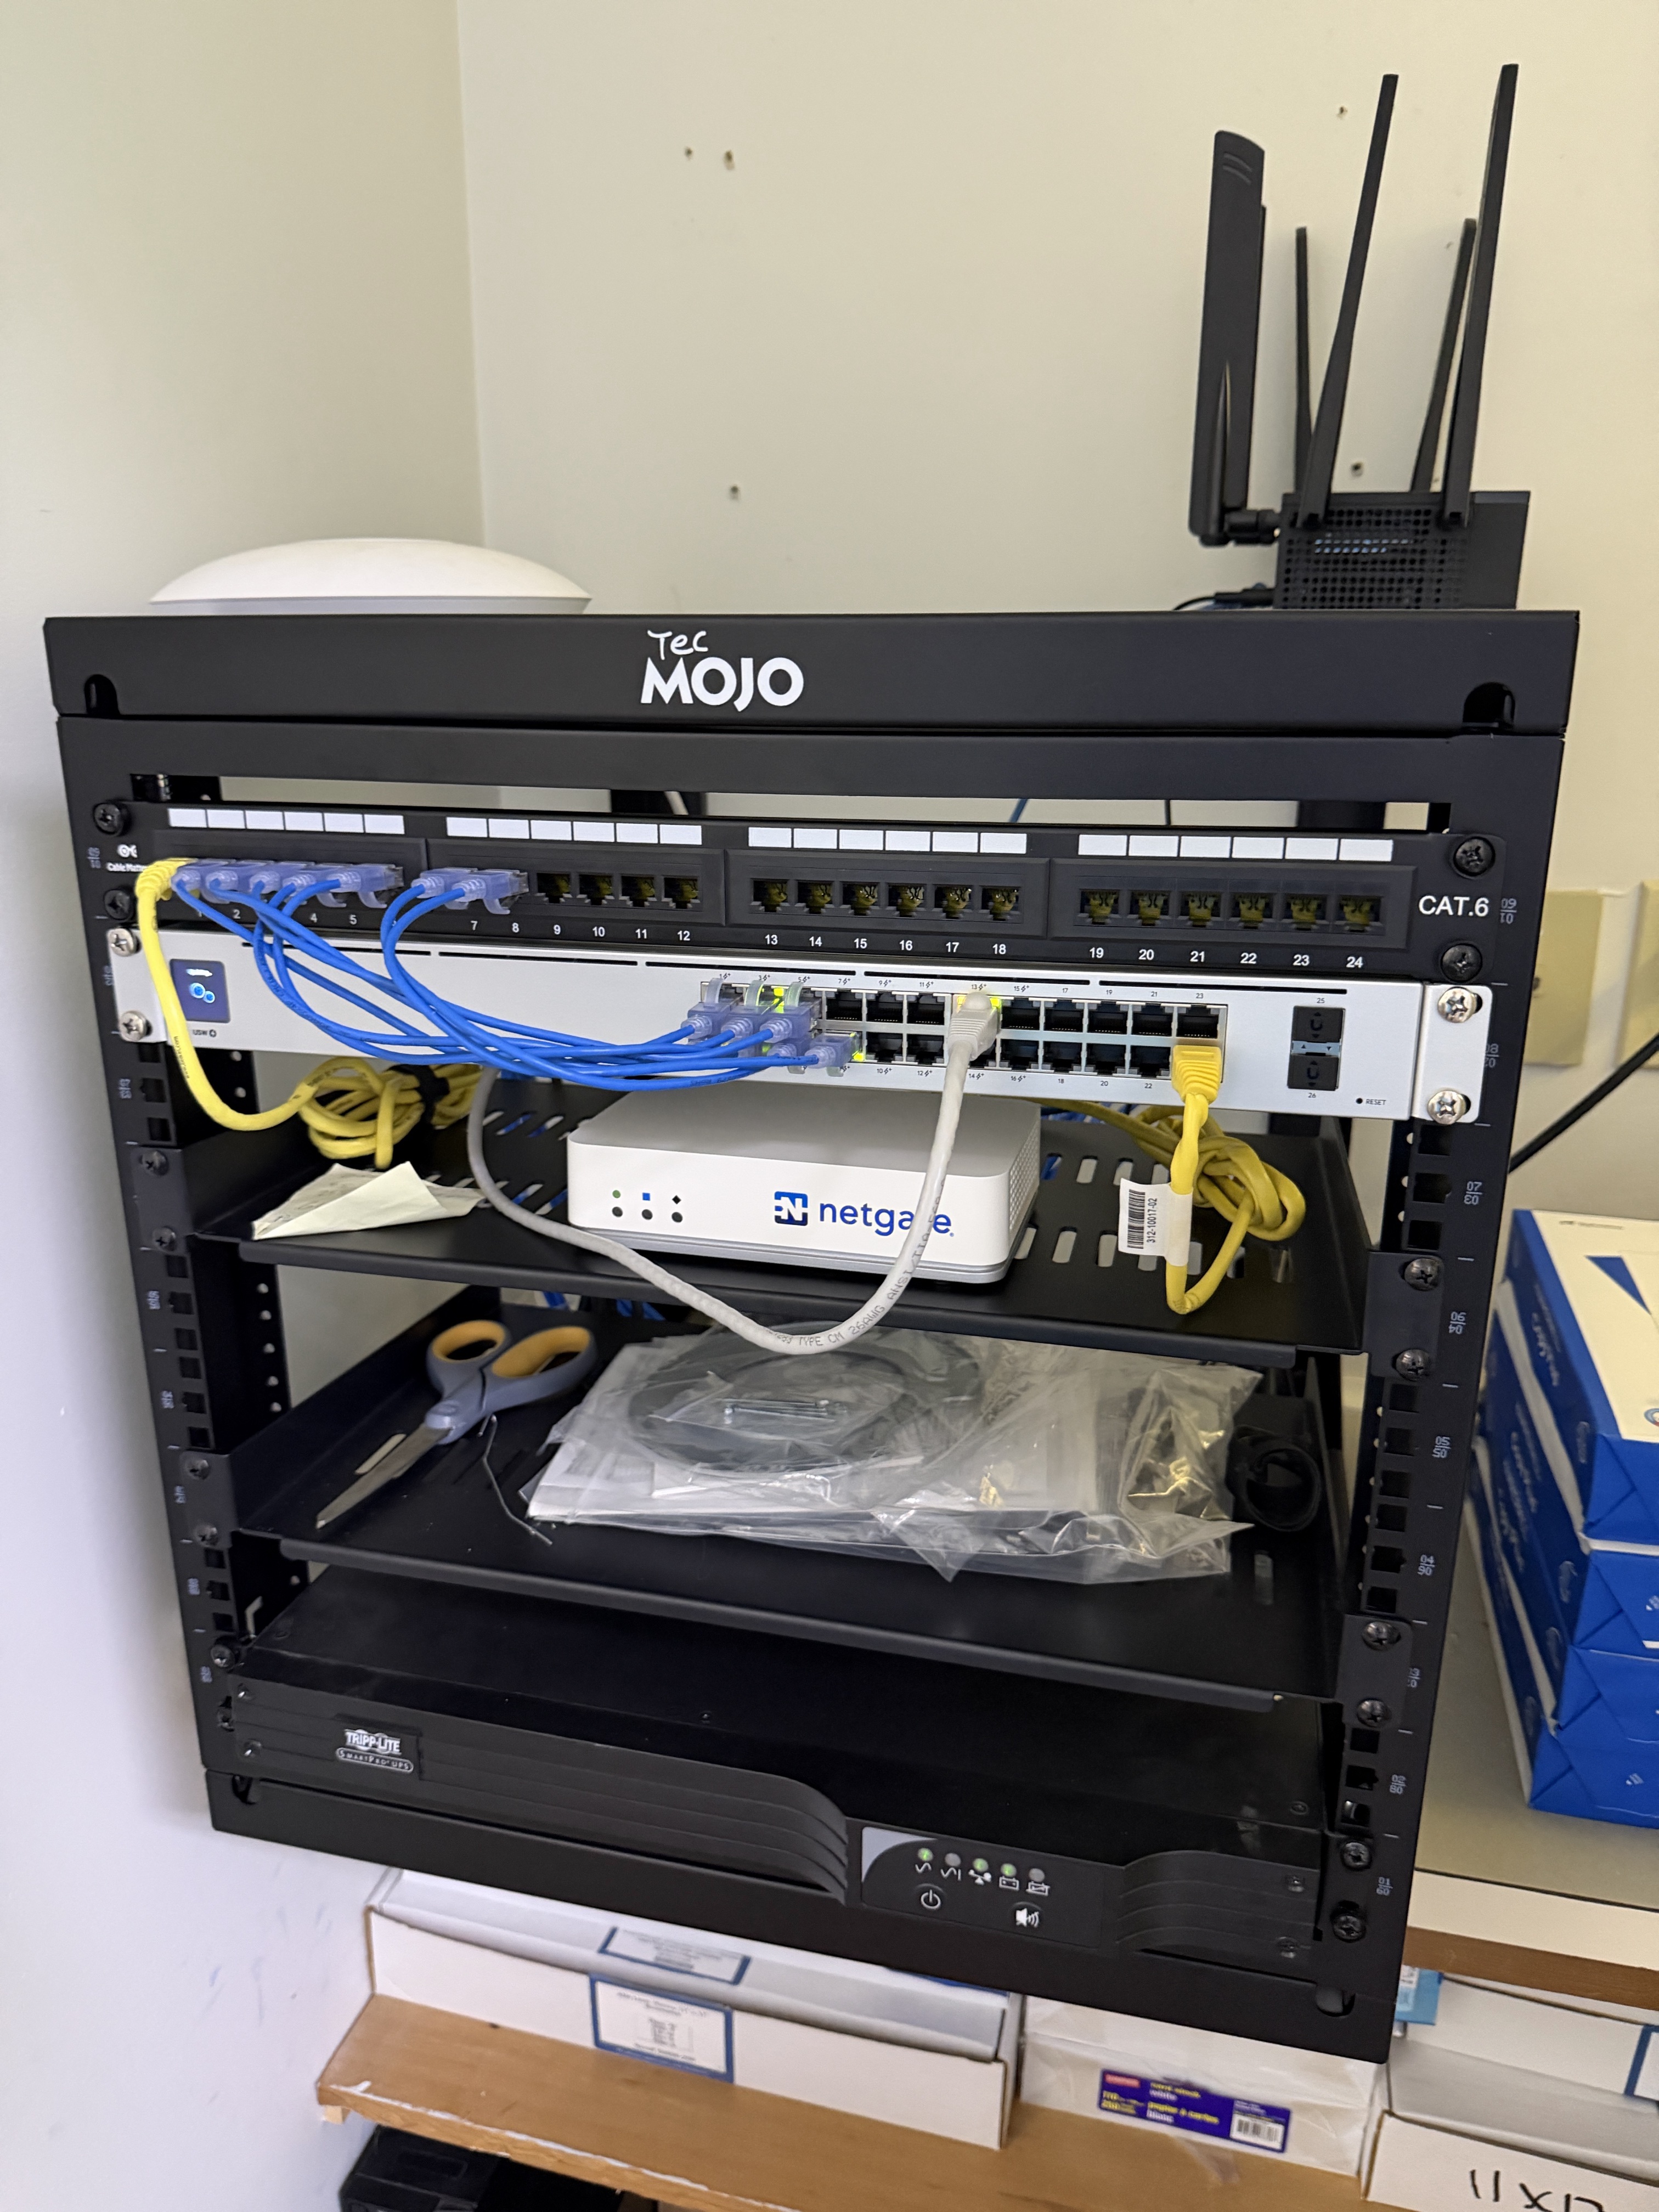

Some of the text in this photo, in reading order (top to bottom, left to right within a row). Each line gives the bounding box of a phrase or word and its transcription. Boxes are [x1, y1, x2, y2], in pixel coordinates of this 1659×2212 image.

[647, 630, 708, 660] Tec
[641, 657, 804, 712] MOJO
[1418, 895, 1489, 917] CAT.6
[233, 909, 241, 919] 2
[310, 913, 318, 923] 4
[349, 915, 357, 925] 5
[471, 920, 478, 930] 7
[512, 922, 520, 933] 8
[554, 924, 561, 935] 9
[592, 926, 605, 937] 10
[635, 928, 647, 939] 11
[678, 930, 690, 941] 12
[765, 934, 778, 945] 13
[809, 936, 822, 947] 14
[854, 938, 867, 949] 15
[899, 940, 913, 951] 16
[946, 941, 960, 953] 17
[992, 944, 1006, 955] 18
[1090, 947, 1104, 958] 19
[1138, 949, 1154, 961] 20
[1190, 951, 1205, 962] 21
[1240, 952, 1257, 964] 22
[1293, 954, 1310, 966] 23
[1346, 956, 1363, 968] 24
[820, 1203, 952, 1237] netgae
[1147, 1198, 1158, 1243] 312-10017-02
[799, 1336, 823, 1346] TYPE
[827, 1331, 846, 1344] CM
